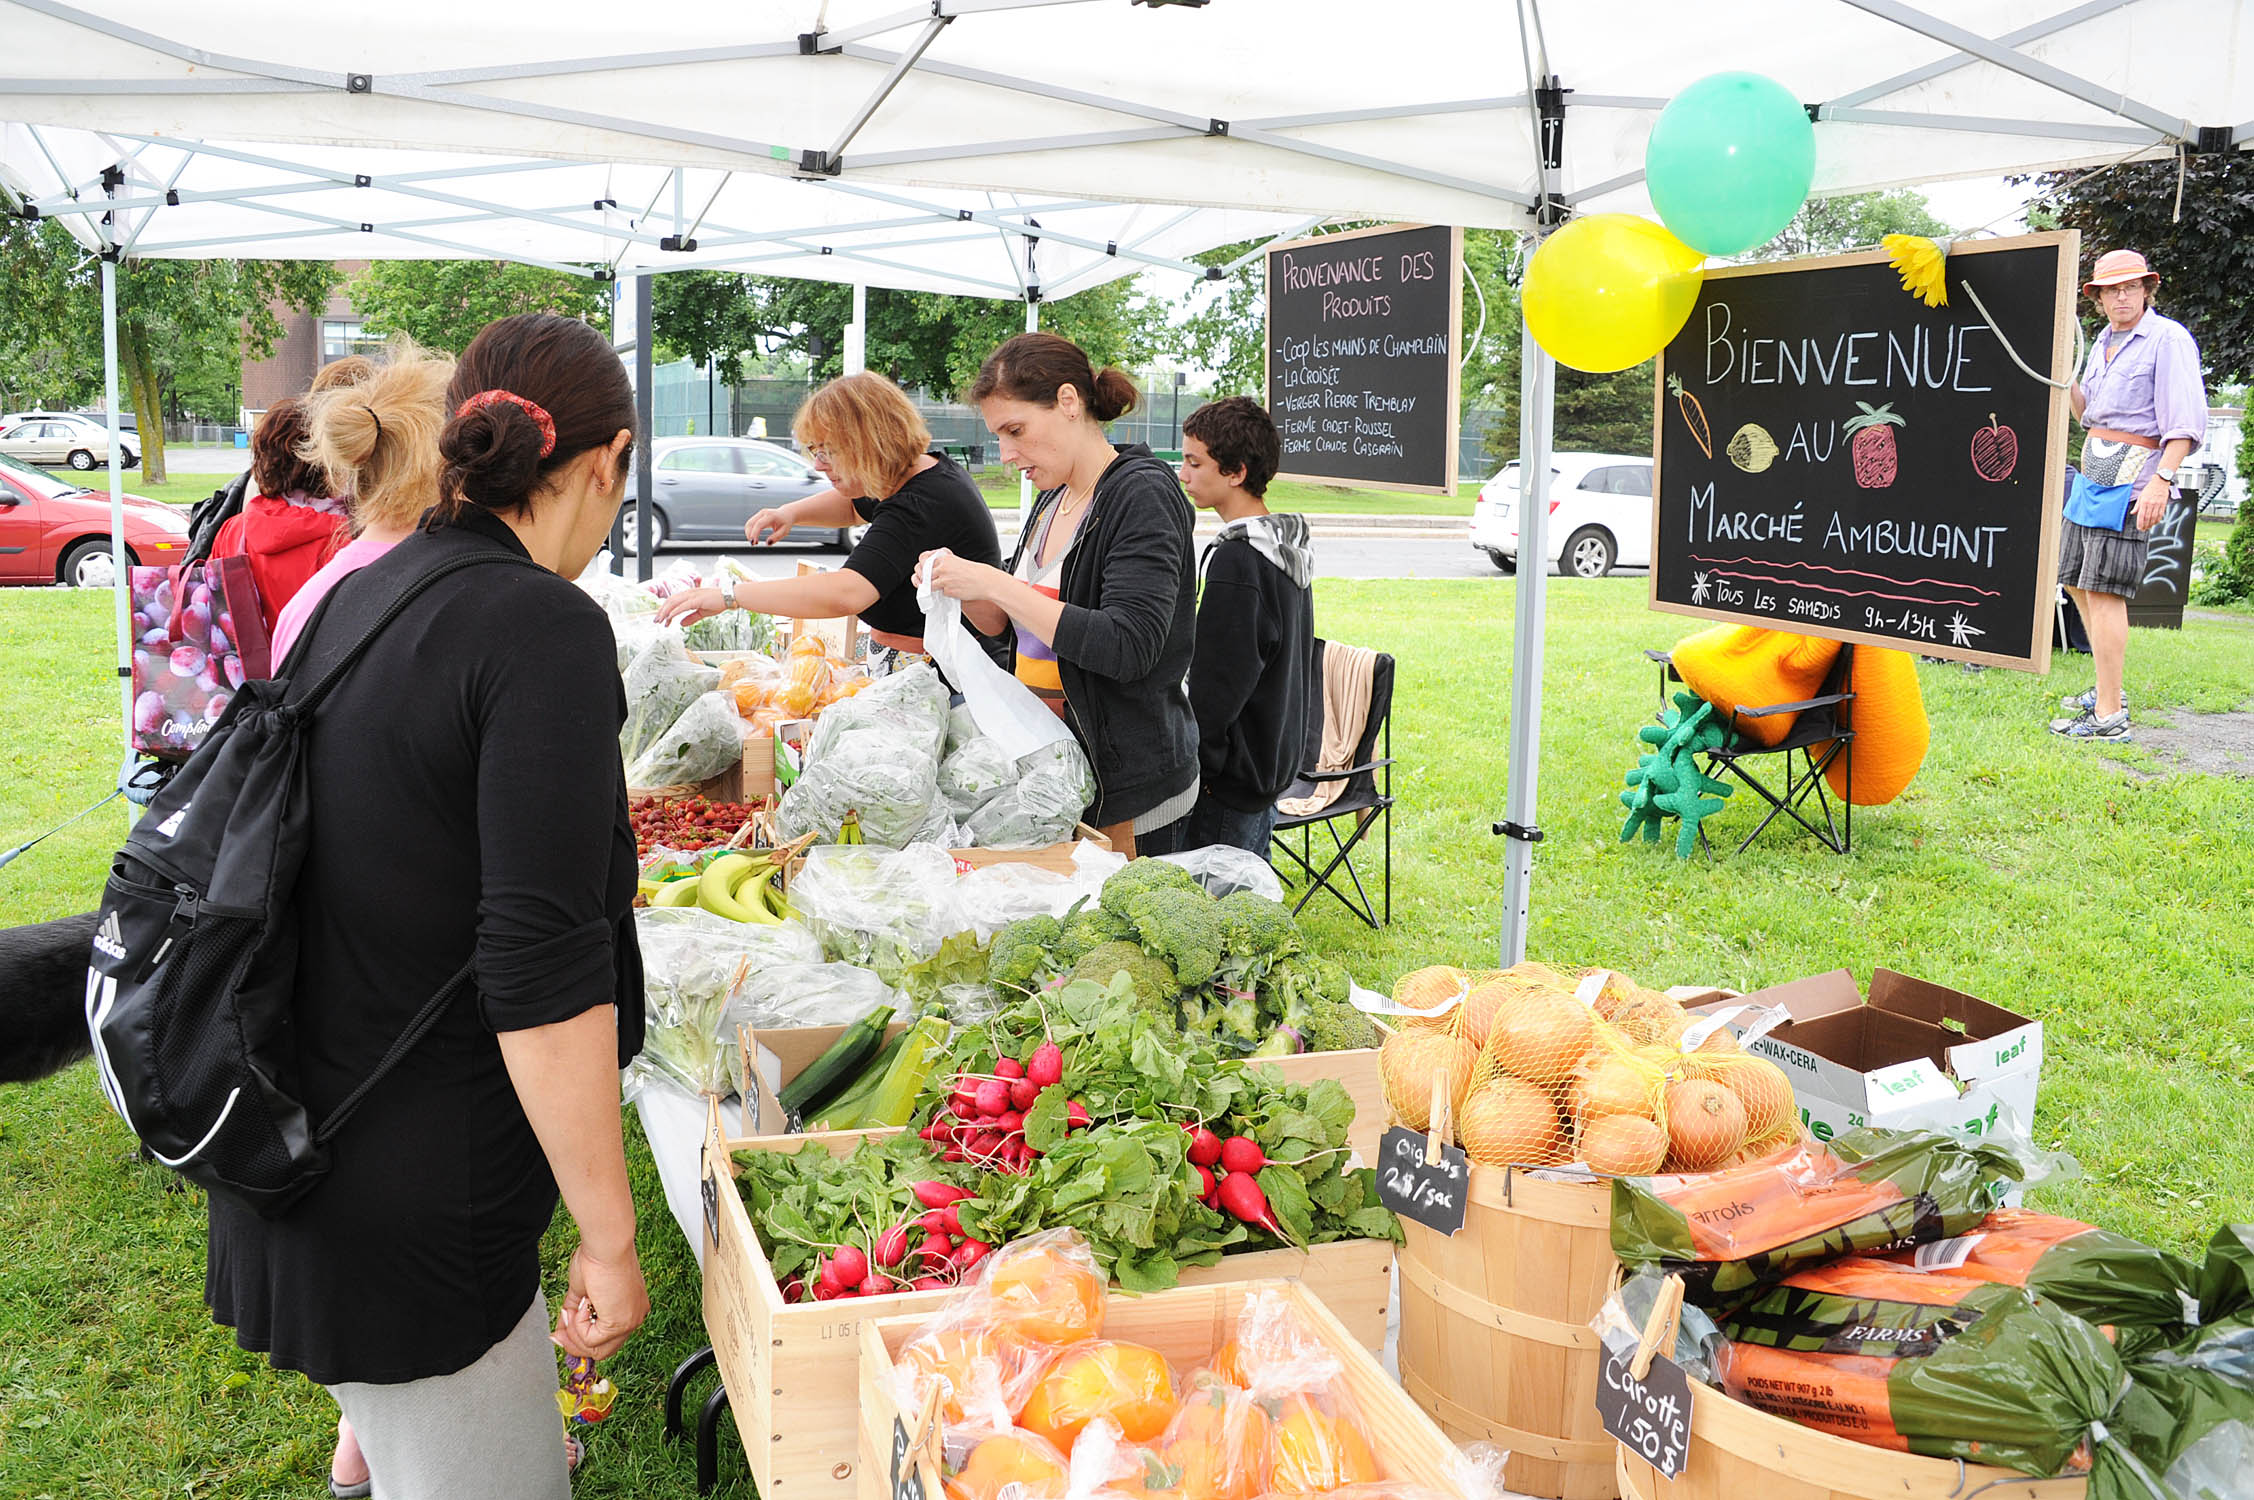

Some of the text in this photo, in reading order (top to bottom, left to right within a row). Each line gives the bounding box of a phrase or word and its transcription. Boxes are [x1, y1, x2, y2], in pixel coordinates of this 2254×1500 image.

[1283, 251, 1434, 295] PROVENANCE DES
[1332, 336, 1367, 357] MAINS
[1369, 338, 1381, 355] DE
[1362, 391, 1416, 413] TREMBLAY
[1784, 419, 1836, 463] AU
[1688, 481, 2008, 569] MARCHÉ AMBULANT
[1754, 588, 1777, 611] LES
[94, 934, 127, 960] adidas
[1995, 1035, 2027, 1068] leaf
[1880, 1070, 1925, 1096] leaf
[1846, 1325, 1928, 1342] FARMS
[1747, 1376, 1769, 1389] POIDS
[1605, 1357, 1685, 1451] Carotte
